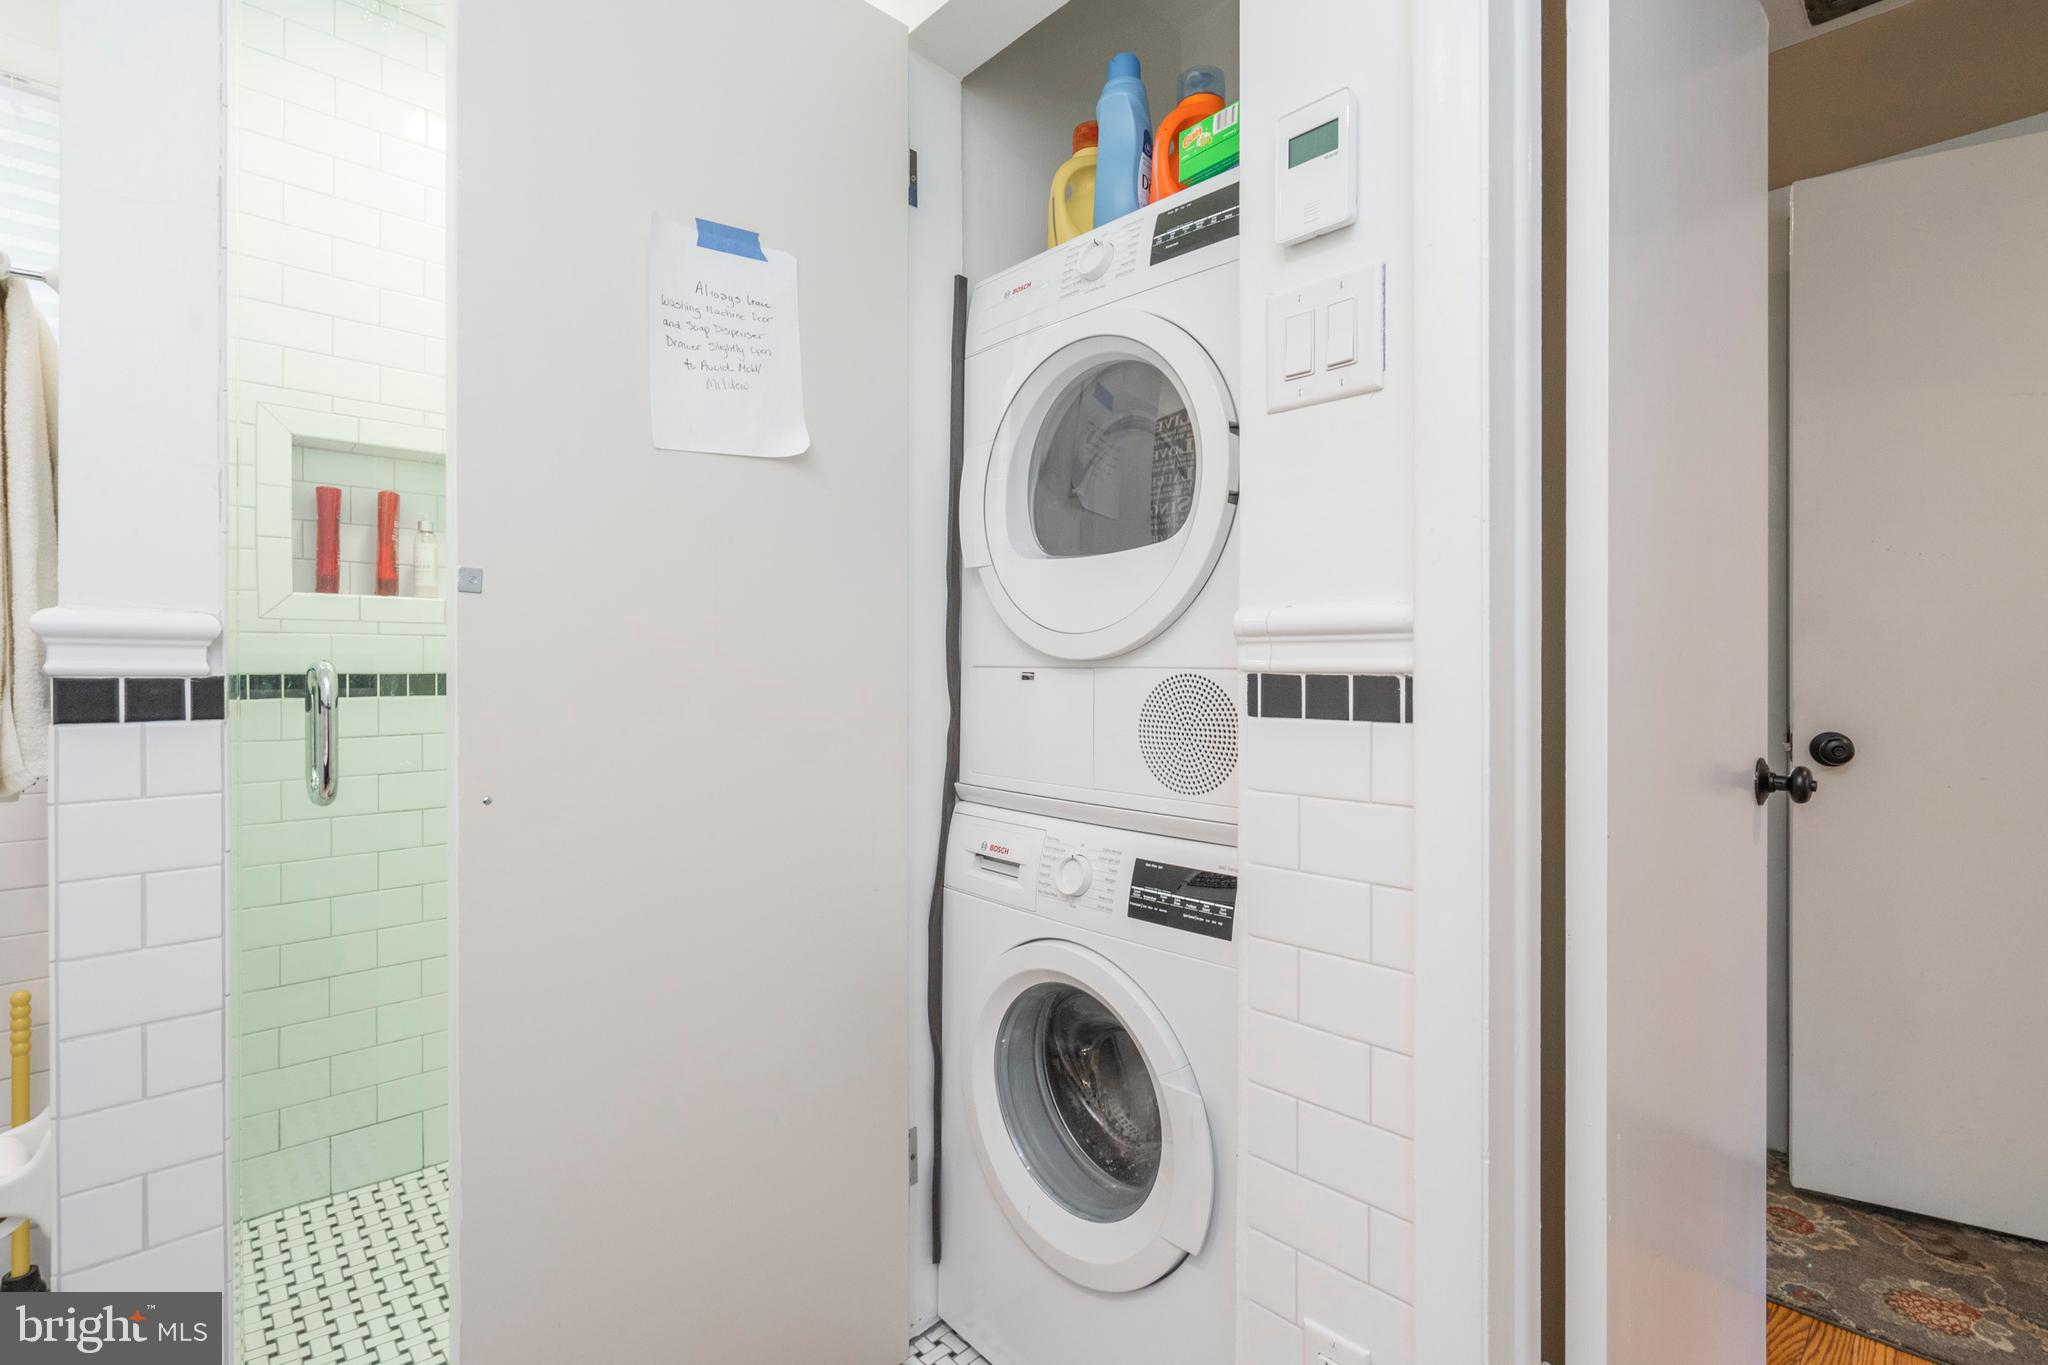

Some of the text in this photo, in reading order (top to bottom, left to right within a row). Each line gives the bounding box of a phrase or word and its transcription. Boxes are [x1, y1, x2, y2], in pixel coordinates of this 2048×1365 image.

[695, 281, 742, 307] Always
[1012, 282, 1032, 294] BOSCH
[661, 294, 702, 319] Washing
[663, 319, 680, 329] and
[666, 335, 701, 351] Drawer
[684, 358, 696, 370] to
[989, 844, 1010, 855] BOSCH
